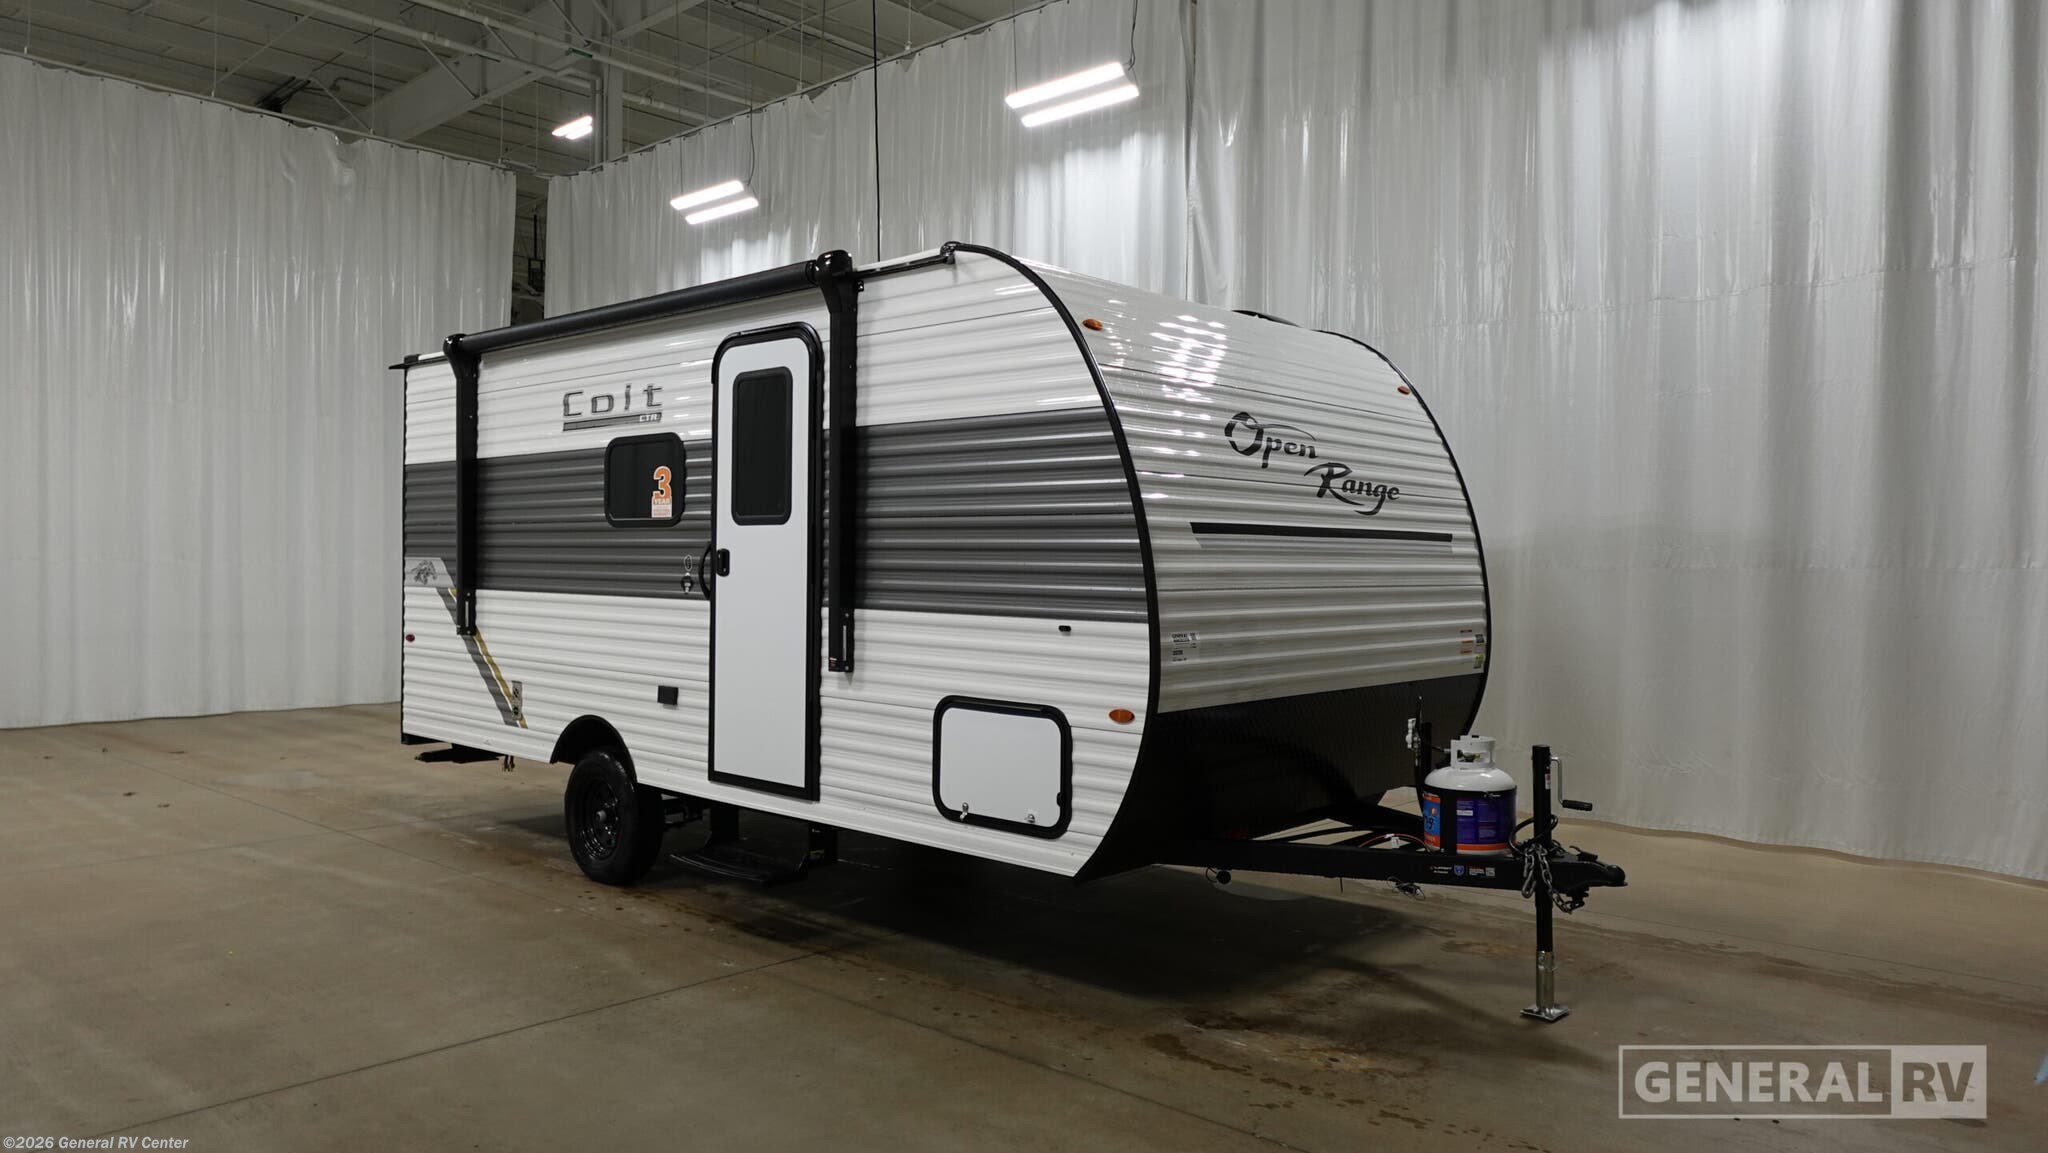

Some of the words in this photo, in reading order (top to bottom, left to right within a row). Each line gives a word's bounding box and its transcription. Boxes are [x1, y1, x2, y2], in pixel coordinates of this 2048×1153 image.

[563, 383, 663, 417] Colt
[1224, 411, 1319, 469] Open
[652, 466, 672, 499] 3
[1303, 462, 1400, 516] Range
